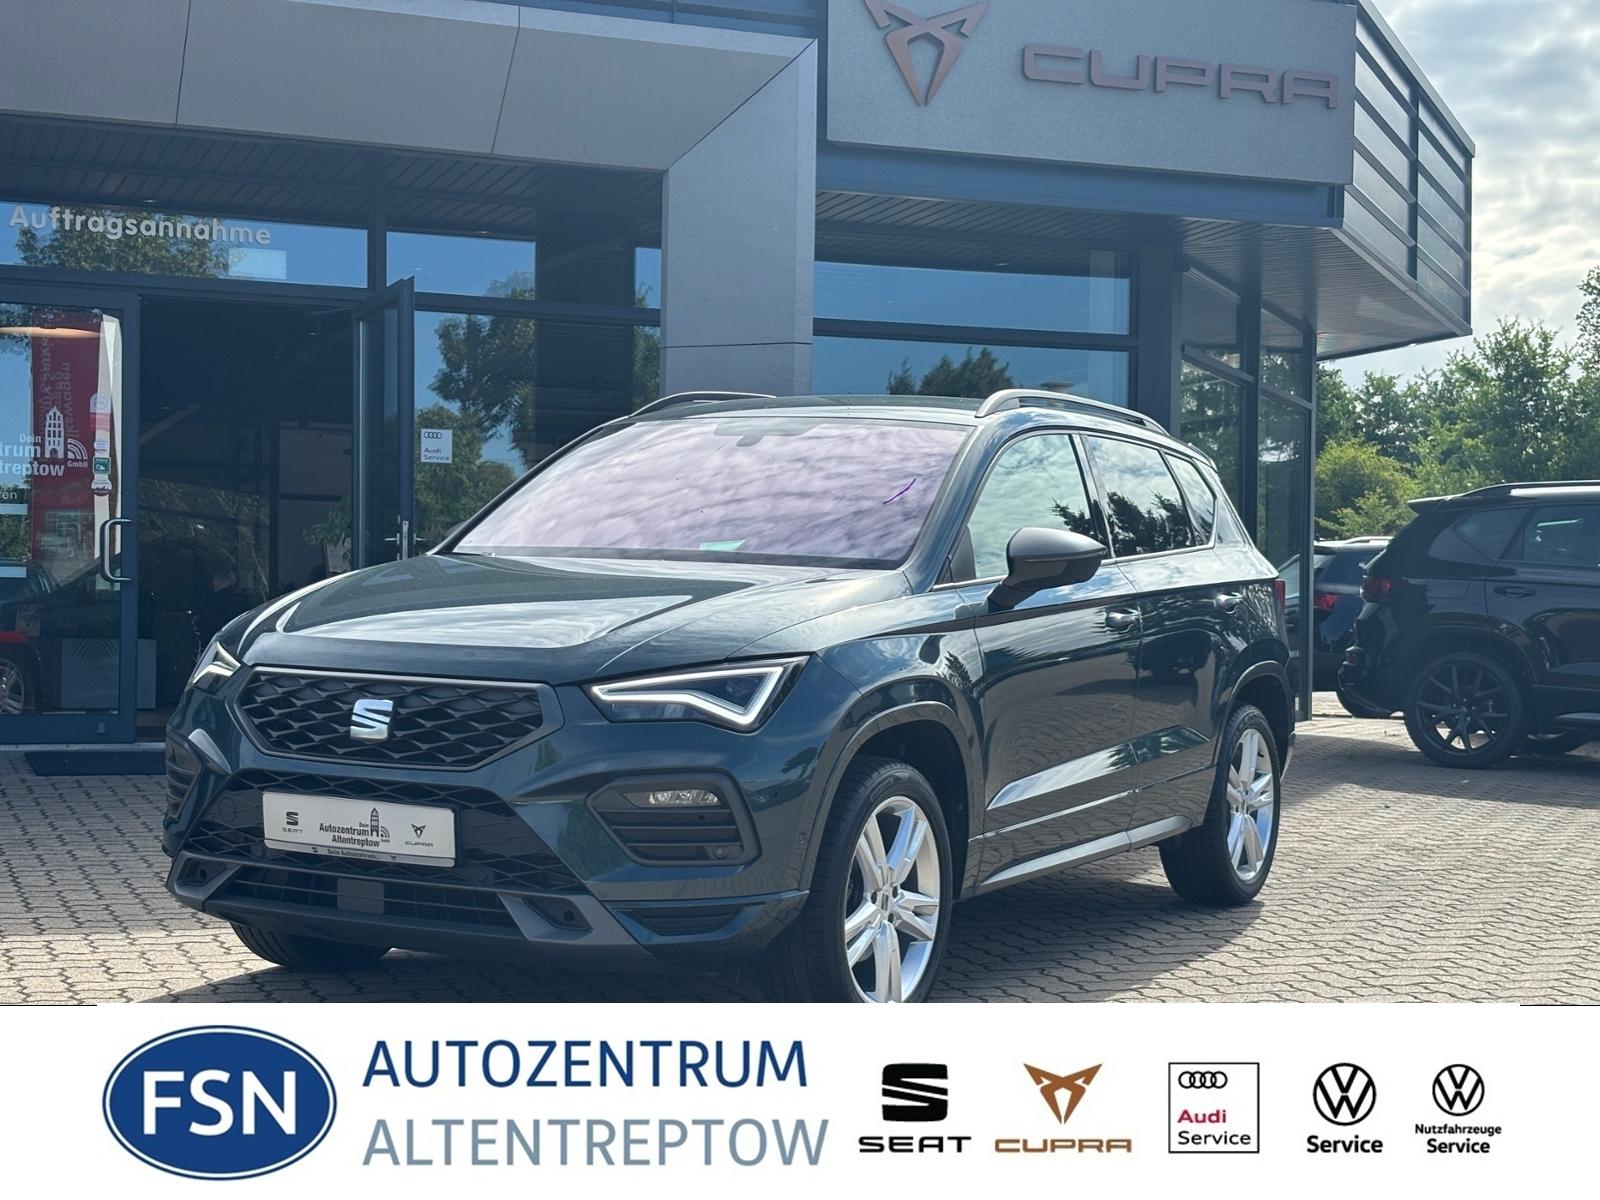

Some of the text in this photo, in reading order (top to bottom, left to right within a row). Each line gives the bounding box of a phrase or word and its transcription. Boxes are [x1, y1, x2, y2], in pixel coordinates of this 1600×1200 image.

[1023, 43, 1338, 109] CUPRA
[9, 206, 272, 245] Auftragsannahme
[20, 433, 42, 443] Dein
[67, 460, 88, 468] GmbH
[319, 822, 370, 836] Autozentrum
[332, 834, 380, 848] Altentreptow
